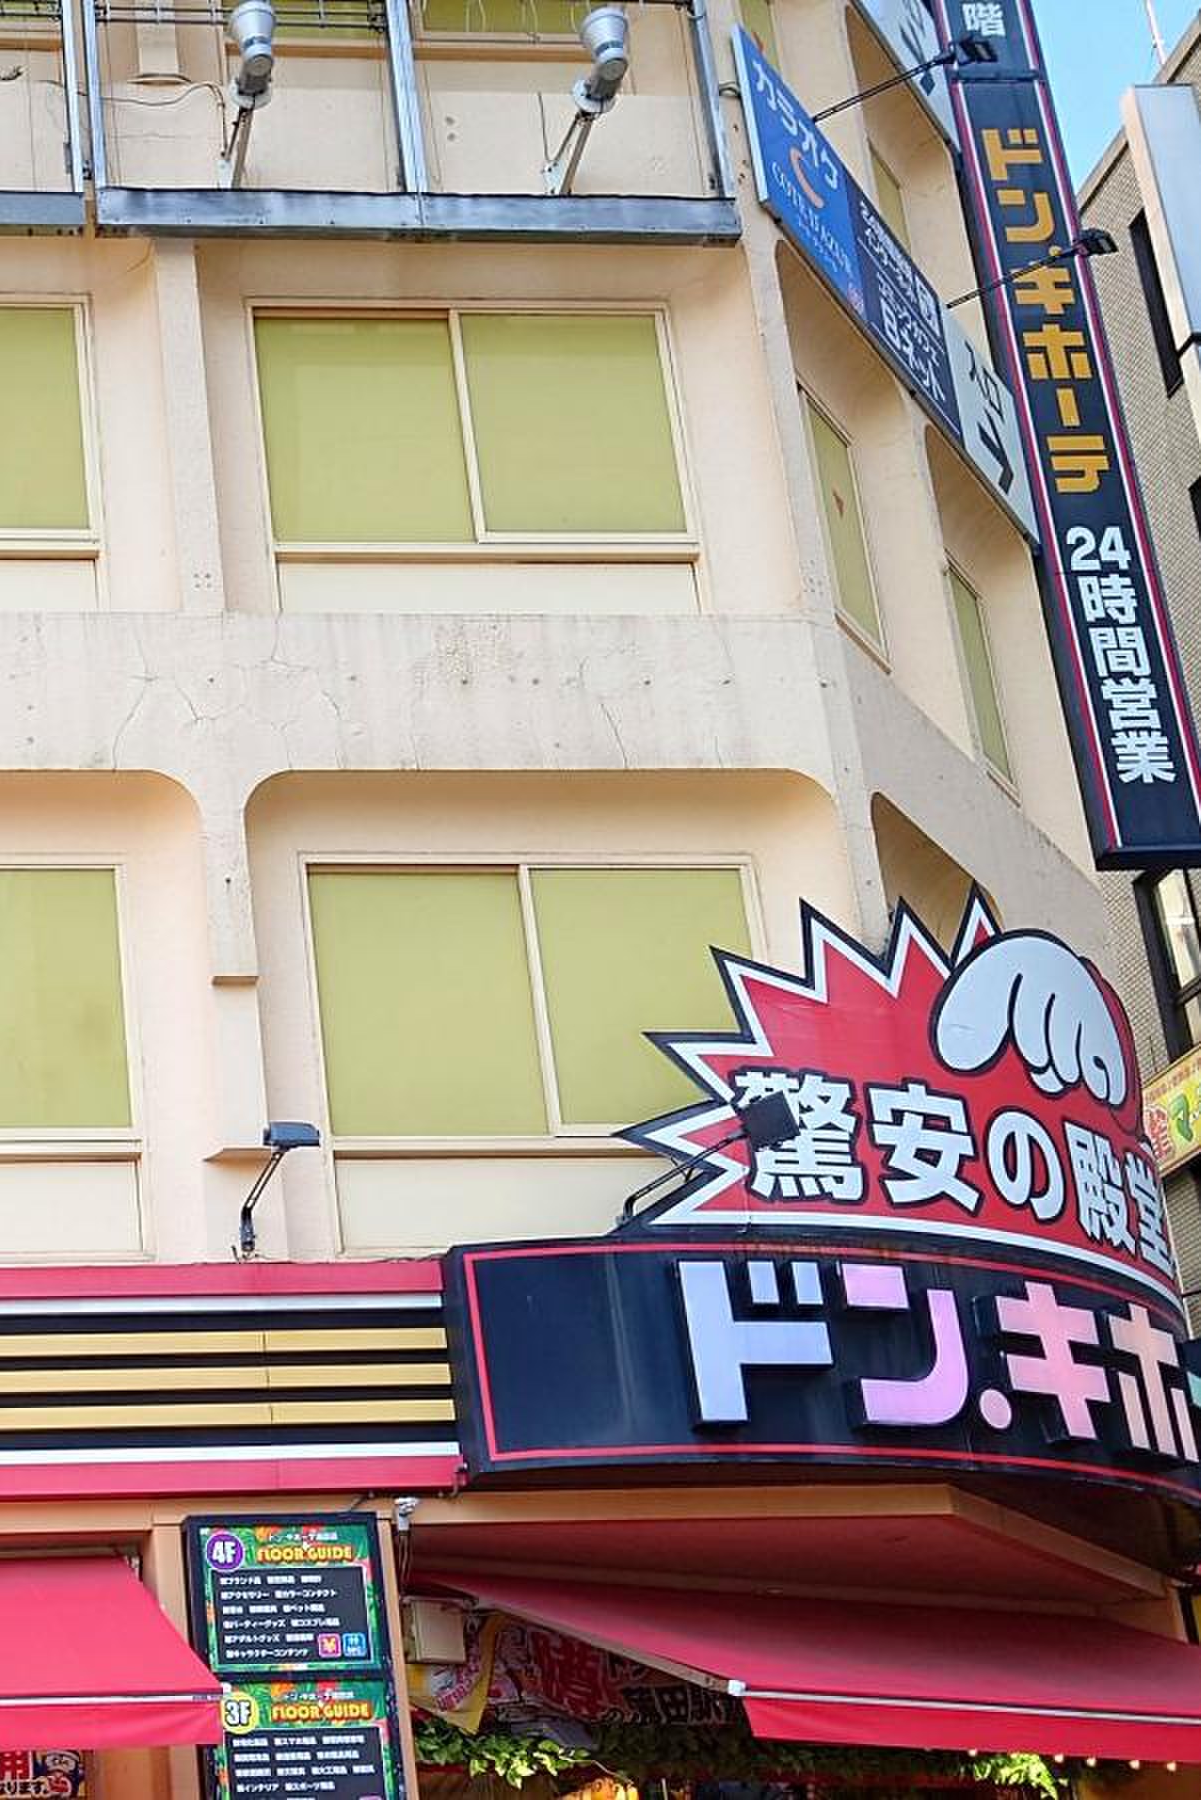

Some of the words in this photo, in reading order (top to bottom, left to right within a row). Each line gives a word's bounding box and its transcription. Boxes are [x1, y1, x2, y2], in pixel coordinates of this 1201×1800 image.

[962, 3, 1006, 37] 階
[752, 59, 838, 190] カラオケ
[1066, 526, 1176, 784] 24時間営業
[734, 1070, 1176, 1281] 驚安の殿堂
[212, 1540, 237, 1564] 4F
[257, 1546, 304, 1562] FLOOR
[306, 1545, 353, 1561] GUIDE
[225, 1700, 251, 1726] 3F
[272, 1703, 320, 1720] FLOOR
[323, 1701, 370, 1718] GUIDE
